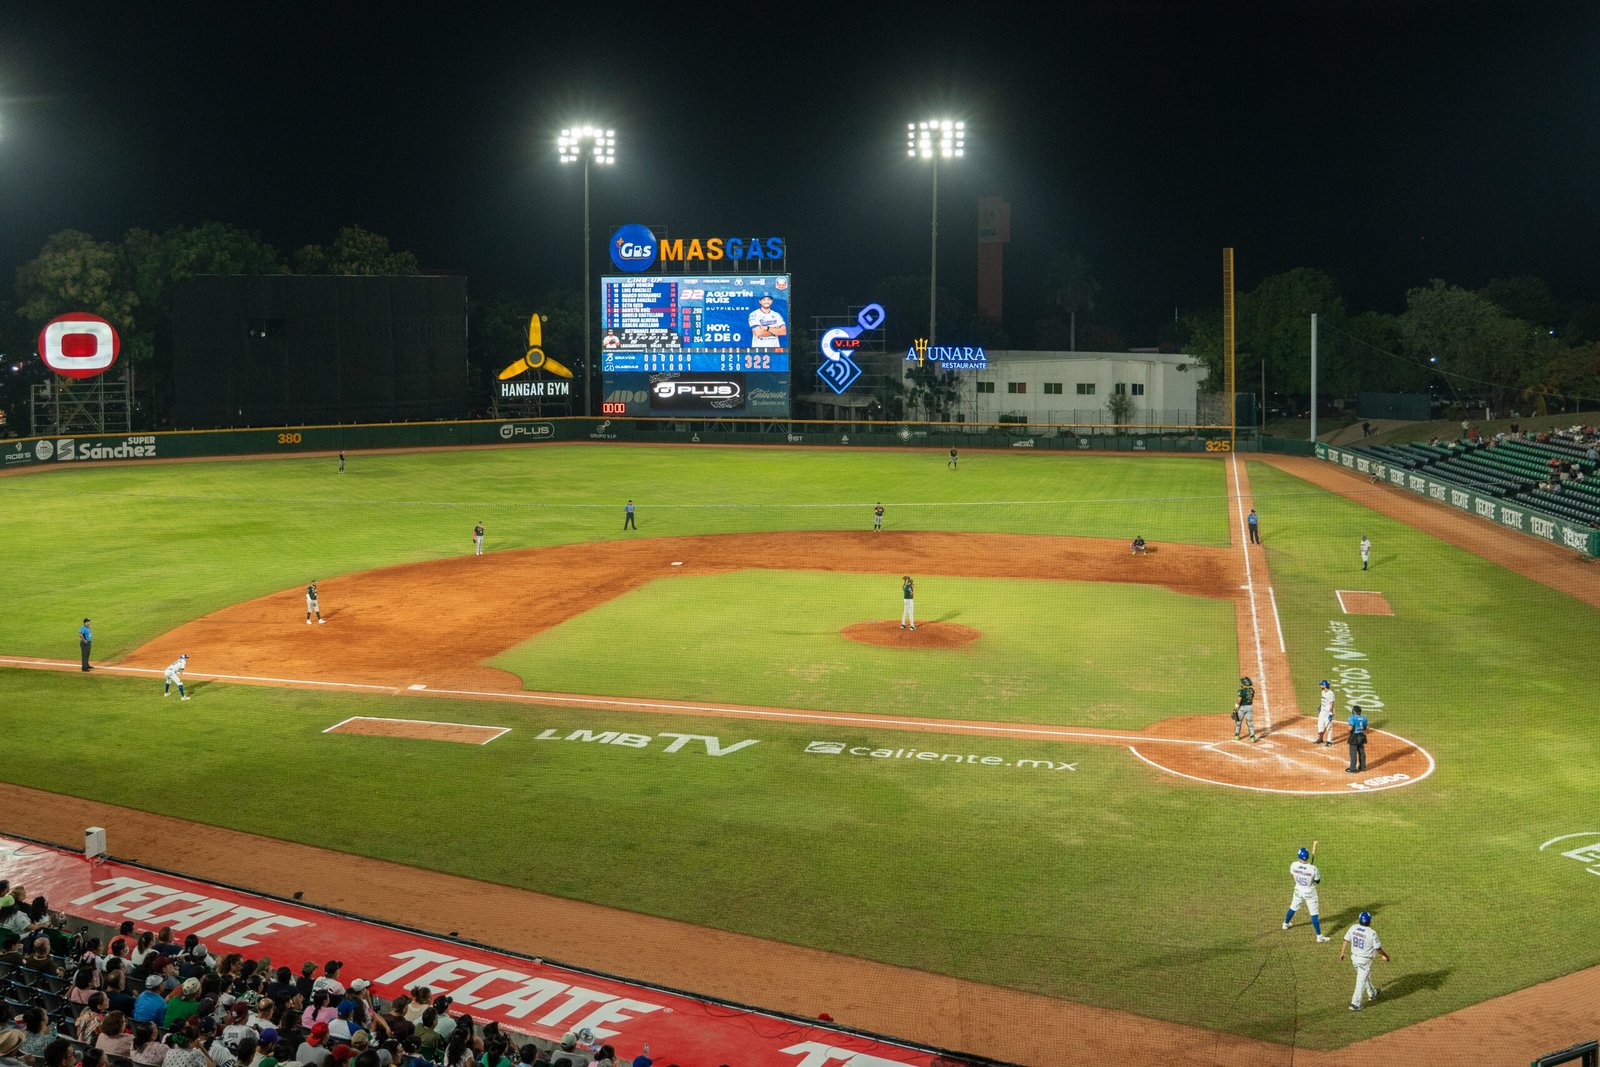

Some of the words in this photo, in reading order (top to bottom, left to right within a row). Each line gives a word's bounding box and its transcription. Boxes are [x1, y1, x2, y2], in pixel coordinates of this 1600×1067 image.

[660, 237, 784, 260] MASGAS
[680, 290, 704, 300] 32
[704, 333, 712, 342] 2
[714, 333, 730, 342] DE
[733, 333, 741, 342] 0
[502, 383, 544, 396] HANGAR
[547, 382, 569, 395] GYM
[677, 386, 732, 394] PLUS
[128, 436, 156, 444] SUPER
[278, 433, 301, 444] 380
[515, 427, 549, 435] PLUS
[80, 442, 156, 460] Sánchez
[1206, 441, 1230, 451] 325
[1452, 490, 1469, 509] TECATE
[1475, 498, 1496, 519] TECATE
[1501, 507, 1523, 529] TECATE
[1530, 516, 1554, 539] TECATE
[534, 729, 652, 748] LMB
[658, 732, 762, 756] TV
[849, 747, 1078, 771] caliente.mx
[70, 876, 310, 947] TECATE
[374, 948, 666, 1039] TECATE
